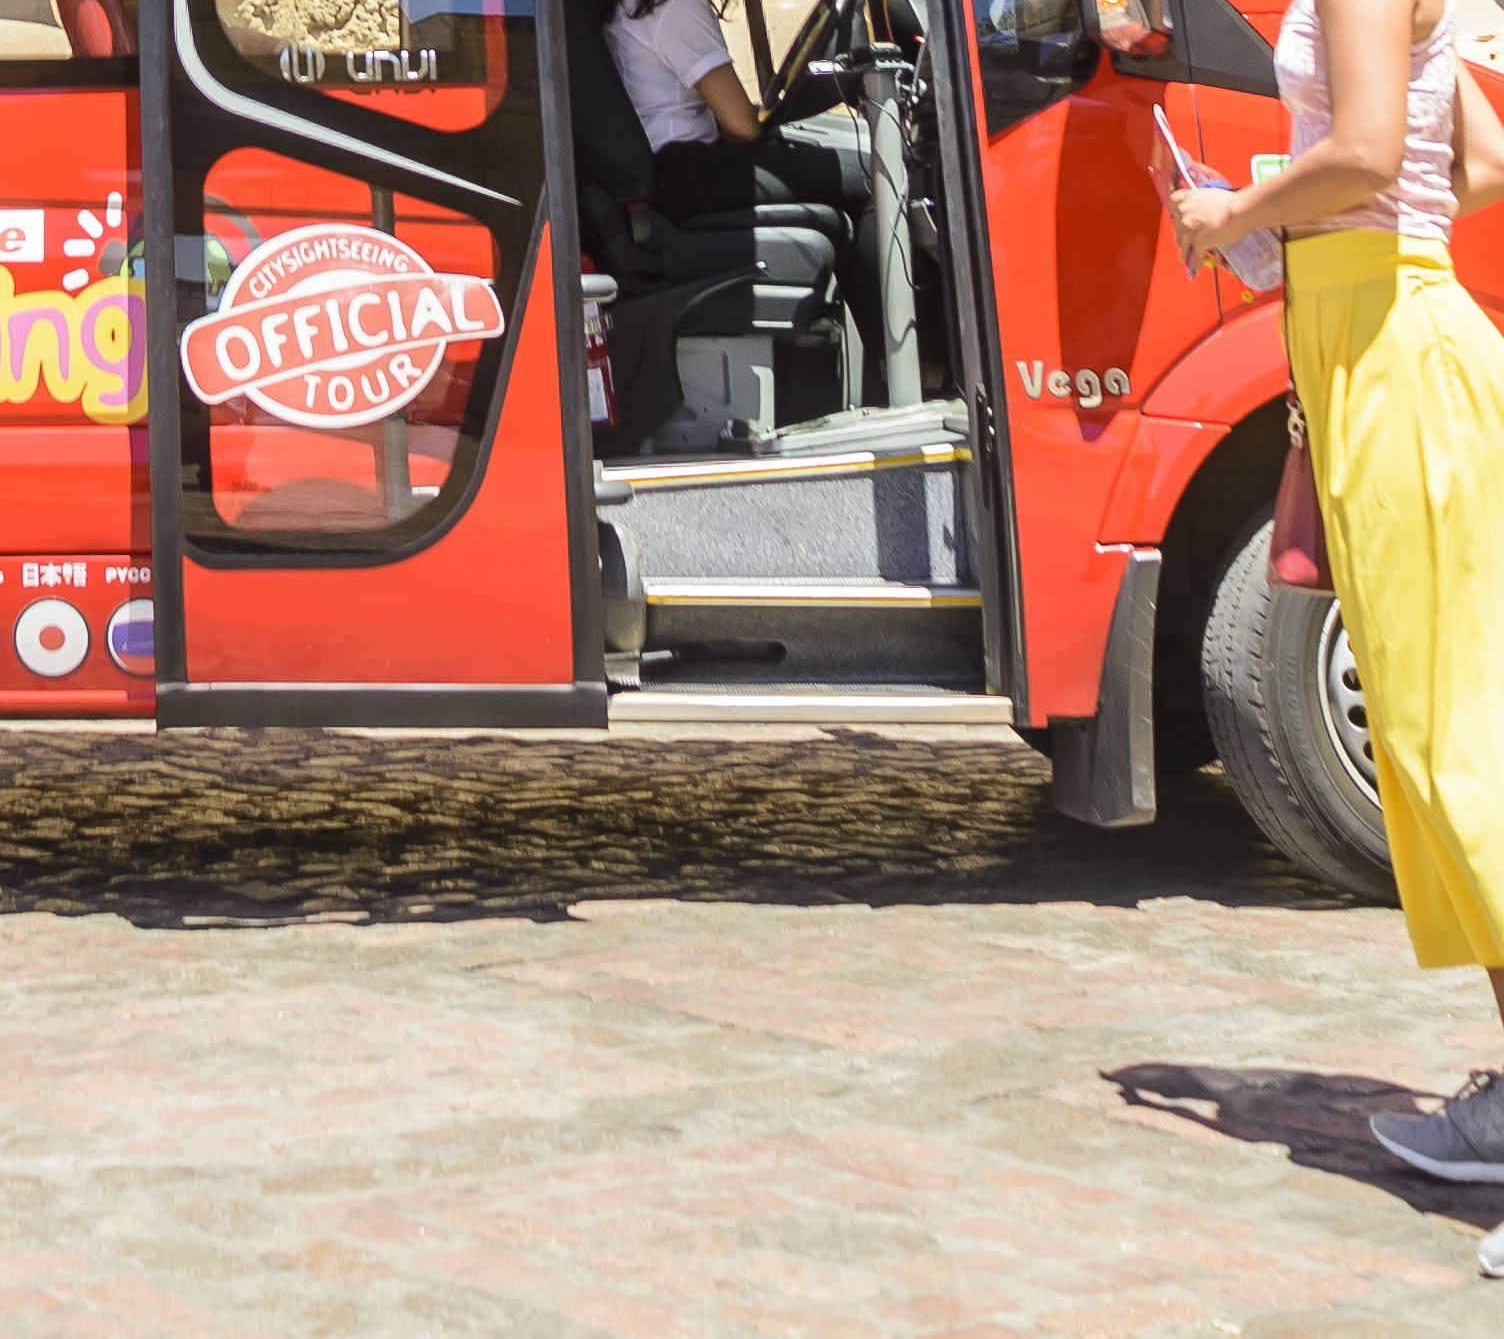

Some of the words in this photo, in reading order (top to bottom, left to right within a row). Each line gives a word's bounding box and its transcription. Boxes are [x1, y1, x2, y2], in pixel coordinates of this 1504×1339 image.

[248, 238, 409, 299] CITYSIGHTSEEING
[215, 286, 485, 381] OFFICIAL
[303, 353, 423, 411] TOUR
[1015, 360, 1131, 409] Vega
[22, 561, 88, 588] 日本語
